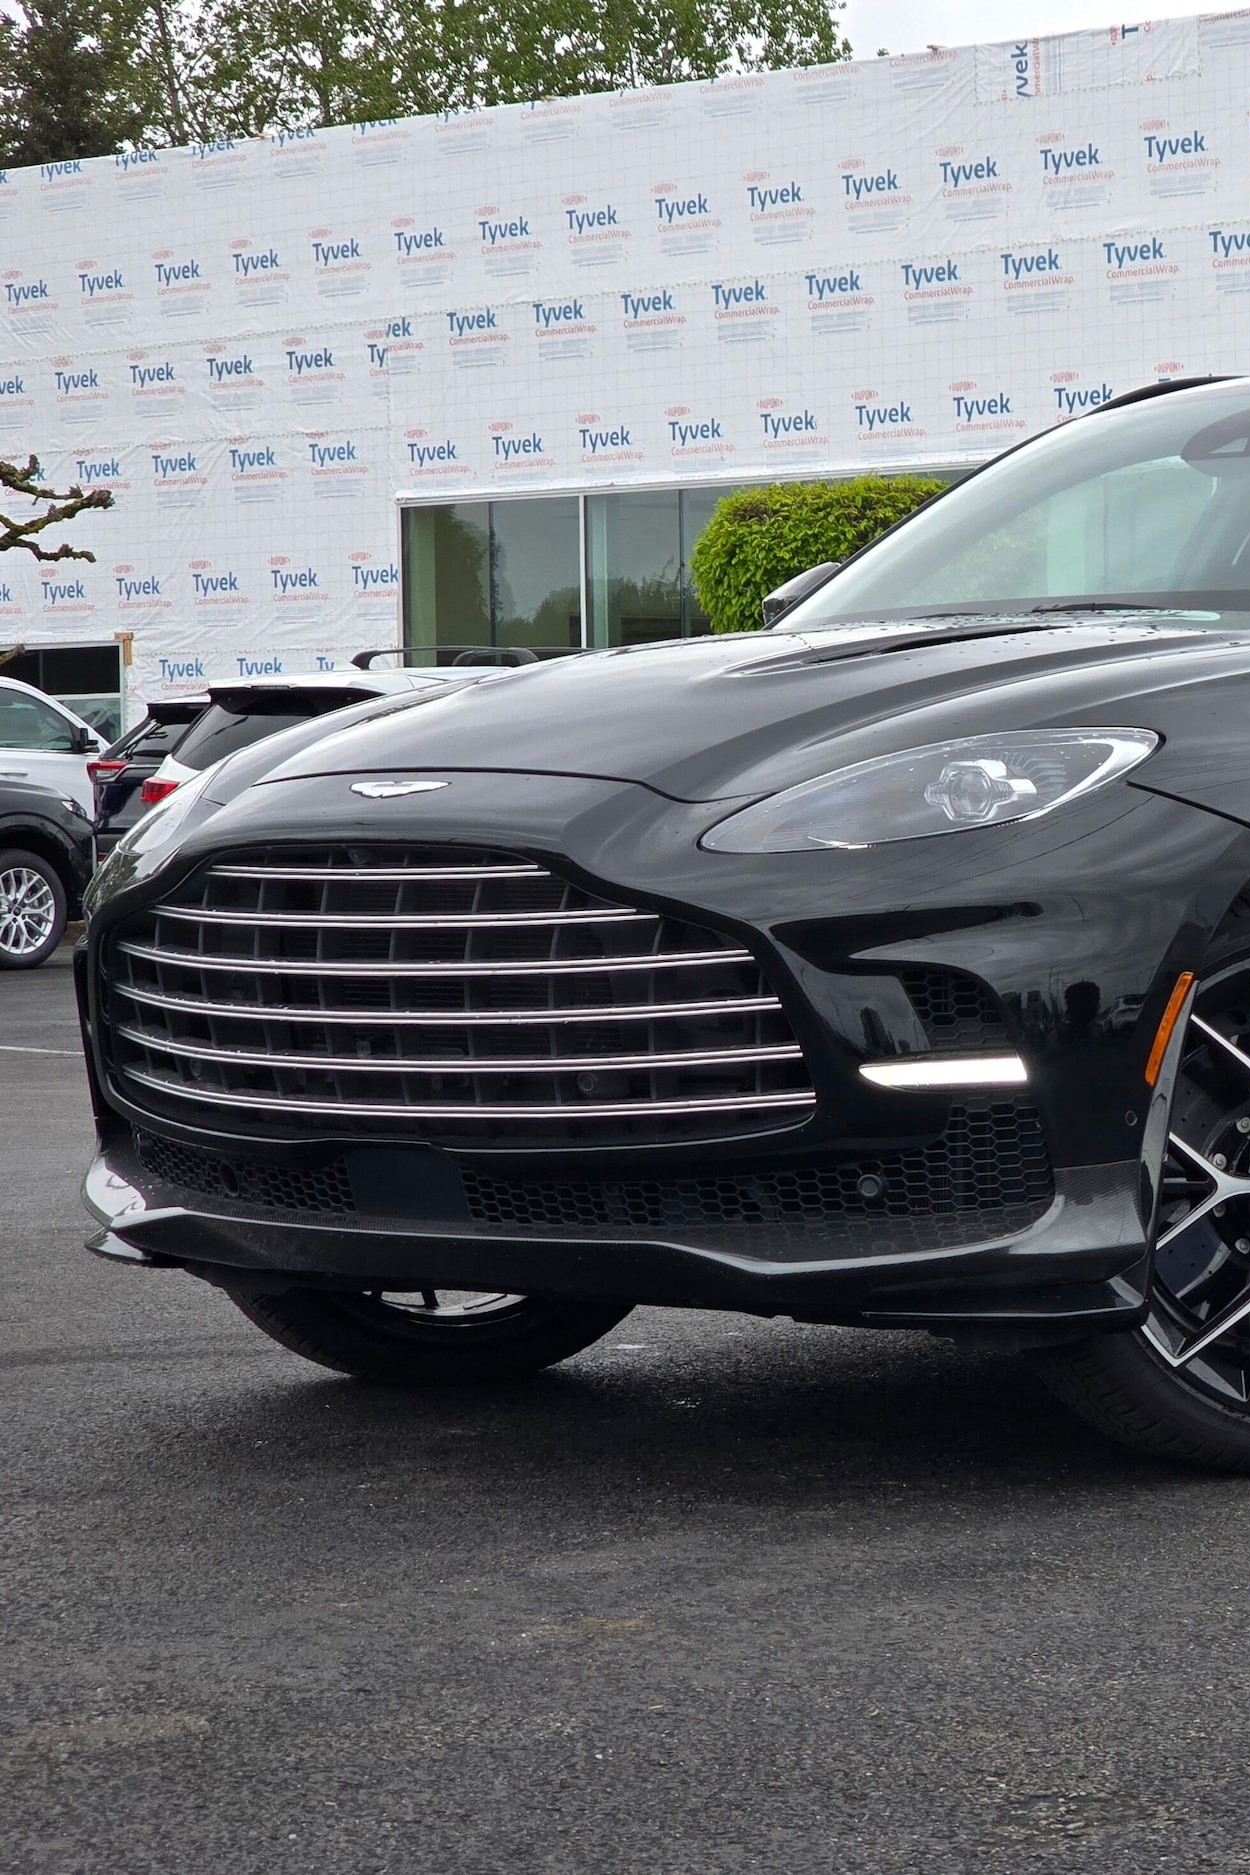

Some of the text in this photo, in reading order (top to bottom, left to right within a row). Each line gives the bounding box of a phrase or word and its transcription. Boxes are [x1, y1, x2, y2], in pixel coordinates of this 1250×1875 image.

[1011, 40, 1035, 98] vek
[1145, 132, 1204, 161] Tyvek
[1041, 144, 1100, 174] Tyvek
[1148, 159, 1218, 172] CommercialWrap
[940, 157, 997, 187] Tyvek
[748, 183, 801, 211] Tyvek
[845, 171, 897, 199] Tyvek
[567, 207, 616, 233] Tyvek
[656, 196, 708, 223] Tyvek
[394, 230, 442, 252] Tyvek
[480, 219, 528, 243] Tyvek
[233, 251, 278, 274] Tyvek
[313, 240, 359, 264] Tyvek
[1104, 238, 1163, 268] Tyvek
[156, 261, 199, 284] Tyvek
[903, 261, 958, 289] Tyvek
[1002, 249, 1059, 280] Tyvek
[1107, 263, 1177, 279] CommercialWrap
[5, 284, 47, 305] Tyvek
[79, 272, 122, 296] Tyvek
[712, 283, 765, 309] Tyvek
[805, 272, 860, 300] Tyvek
[534, 301, 583, 327] Tyvek
[621, 291, 673, 319] Tyvek
[386, 316, 412, 338] vek
[447, 310, 496, 336] Tyvek
[208, 356, 252, 381] Tyvek
[288, 350, 333, 372] Tyvek
[0, 375, 23, 394] vek
[56, 372, 97, 393] Tyvek
[130, 364, 173, 387] Tyvek
[856, 401, 910, 429] Tyvek
[953, 395, 1010, 422] Tyvek
[669, 420, 721, 445] Tyvek
[762, 412, 815, 437] Tyvek
[494, 436, 542, 460] Tyvek
[579, 427, 630, 452] Tyvek
[152, 453, 196, 476] Tyvek
[229, 448, 275, 471] Tyvek
[309, 442, 355, 465] Tyvek
[408, 442, 457, 464] Tyvek
[77, 459, 119, 482] Tyvek
[193, 572, 237, 595] Tyvek
[272, 570, 317, 591] Tyvek
[352, 564, 398, 589] Tyvek
[42, 580, 83, 603] Tyvek
[116, 578, 160, 600] Tyvek
[160, 659, 203, 681] Tyvek
